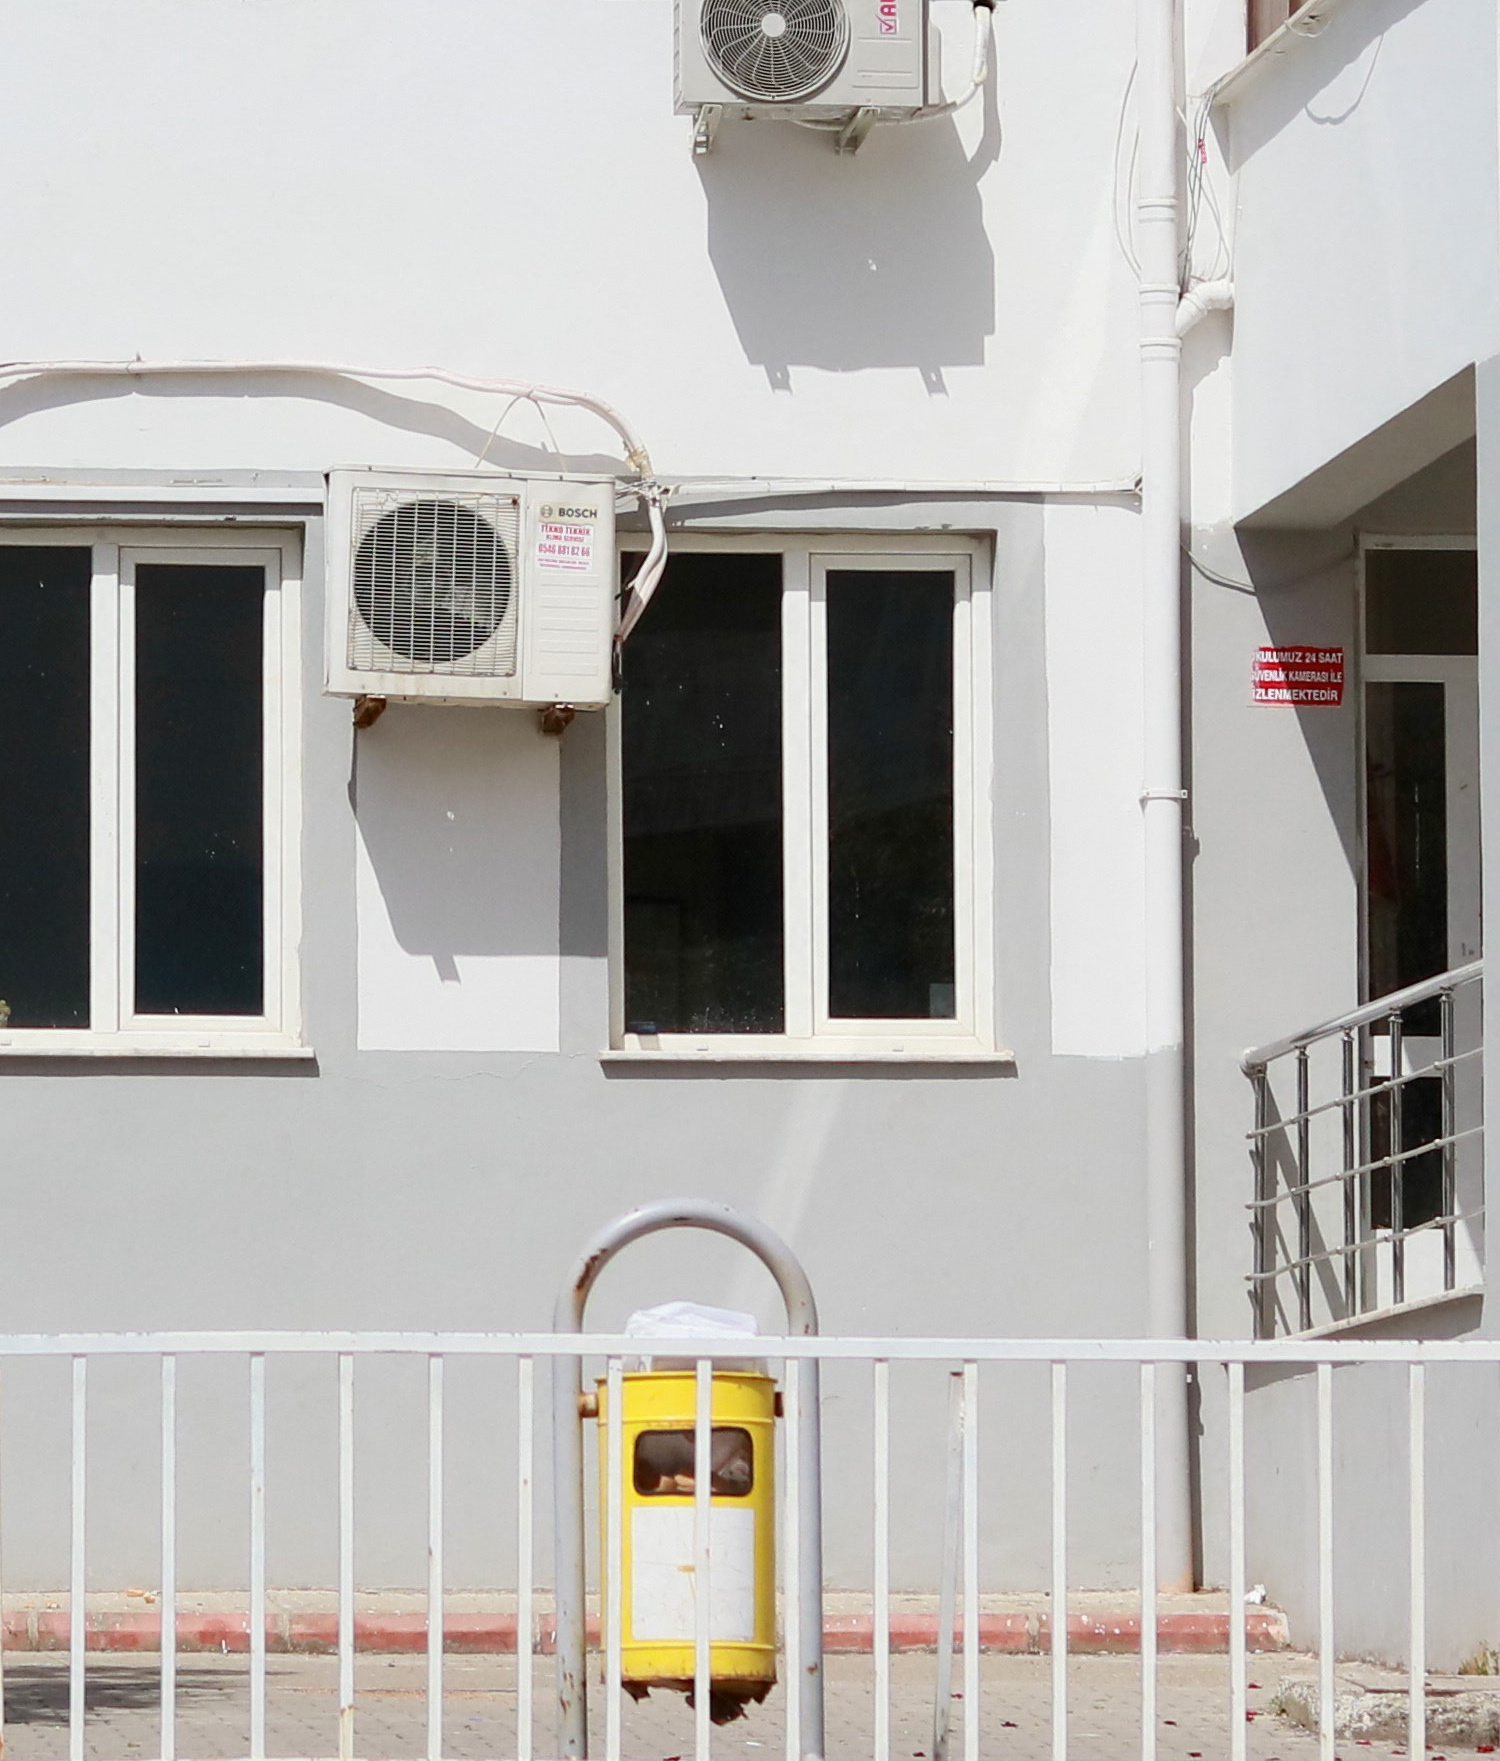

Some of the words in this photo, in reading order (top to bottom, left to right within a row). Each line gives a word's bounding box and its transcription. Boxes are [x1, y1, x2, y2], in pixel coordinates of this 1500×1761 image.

[558, 507, 598, 519] BOSCH
[1304, 652, 1317, 663] 24
[1318, 652, 1343, 663] SAAT
[1288, 671, 1329, 682] KAMERASI
[1330, 669, 1343, 683] İLE
[1252, 687, 1339, 701] İZLENMEKTEDİR
